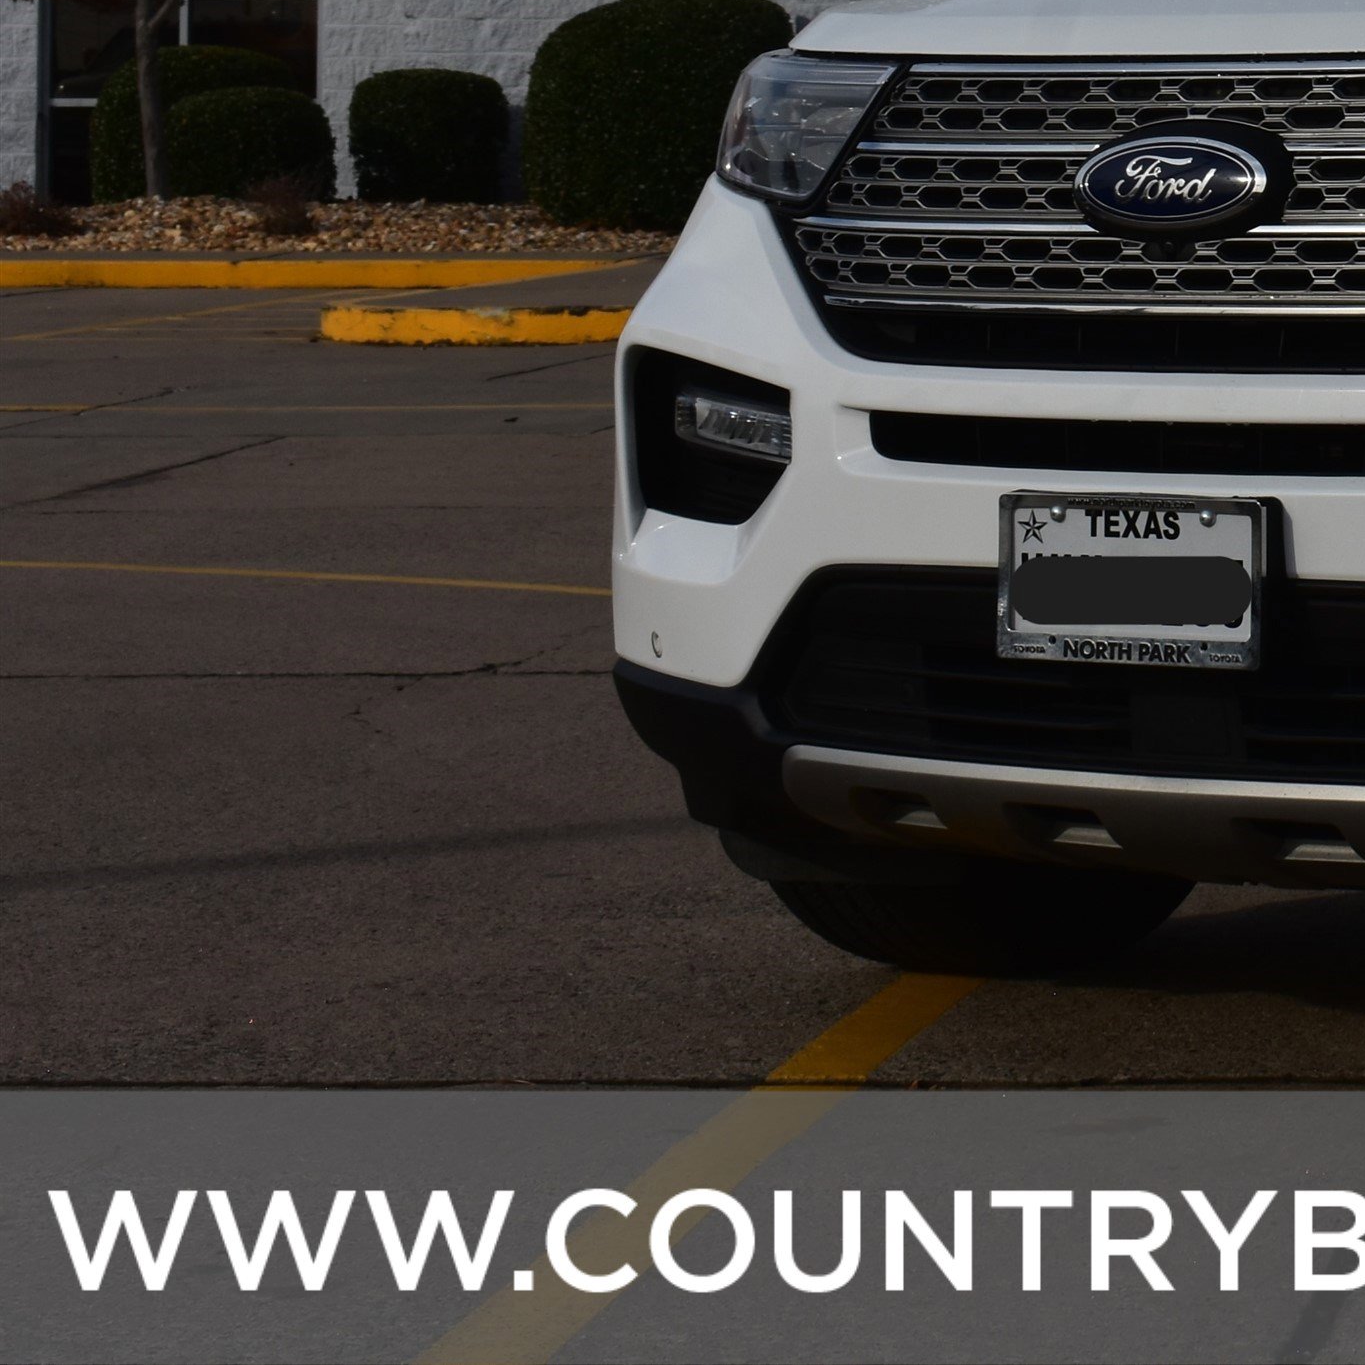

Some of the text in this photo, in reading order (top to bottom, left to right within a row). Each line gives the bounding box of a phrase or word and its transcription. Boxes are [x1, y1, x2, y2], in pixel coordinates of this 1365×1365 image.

[1115, 155, 1217, 203] Ford
[1085, 509, 1181, 541] TEXAS
[1013, 643, 1046, 655] TOYOTA
[1063, 638, 1191, 664] NORTH PARK
[1209, 653, 1242, 664] TOYOTA
